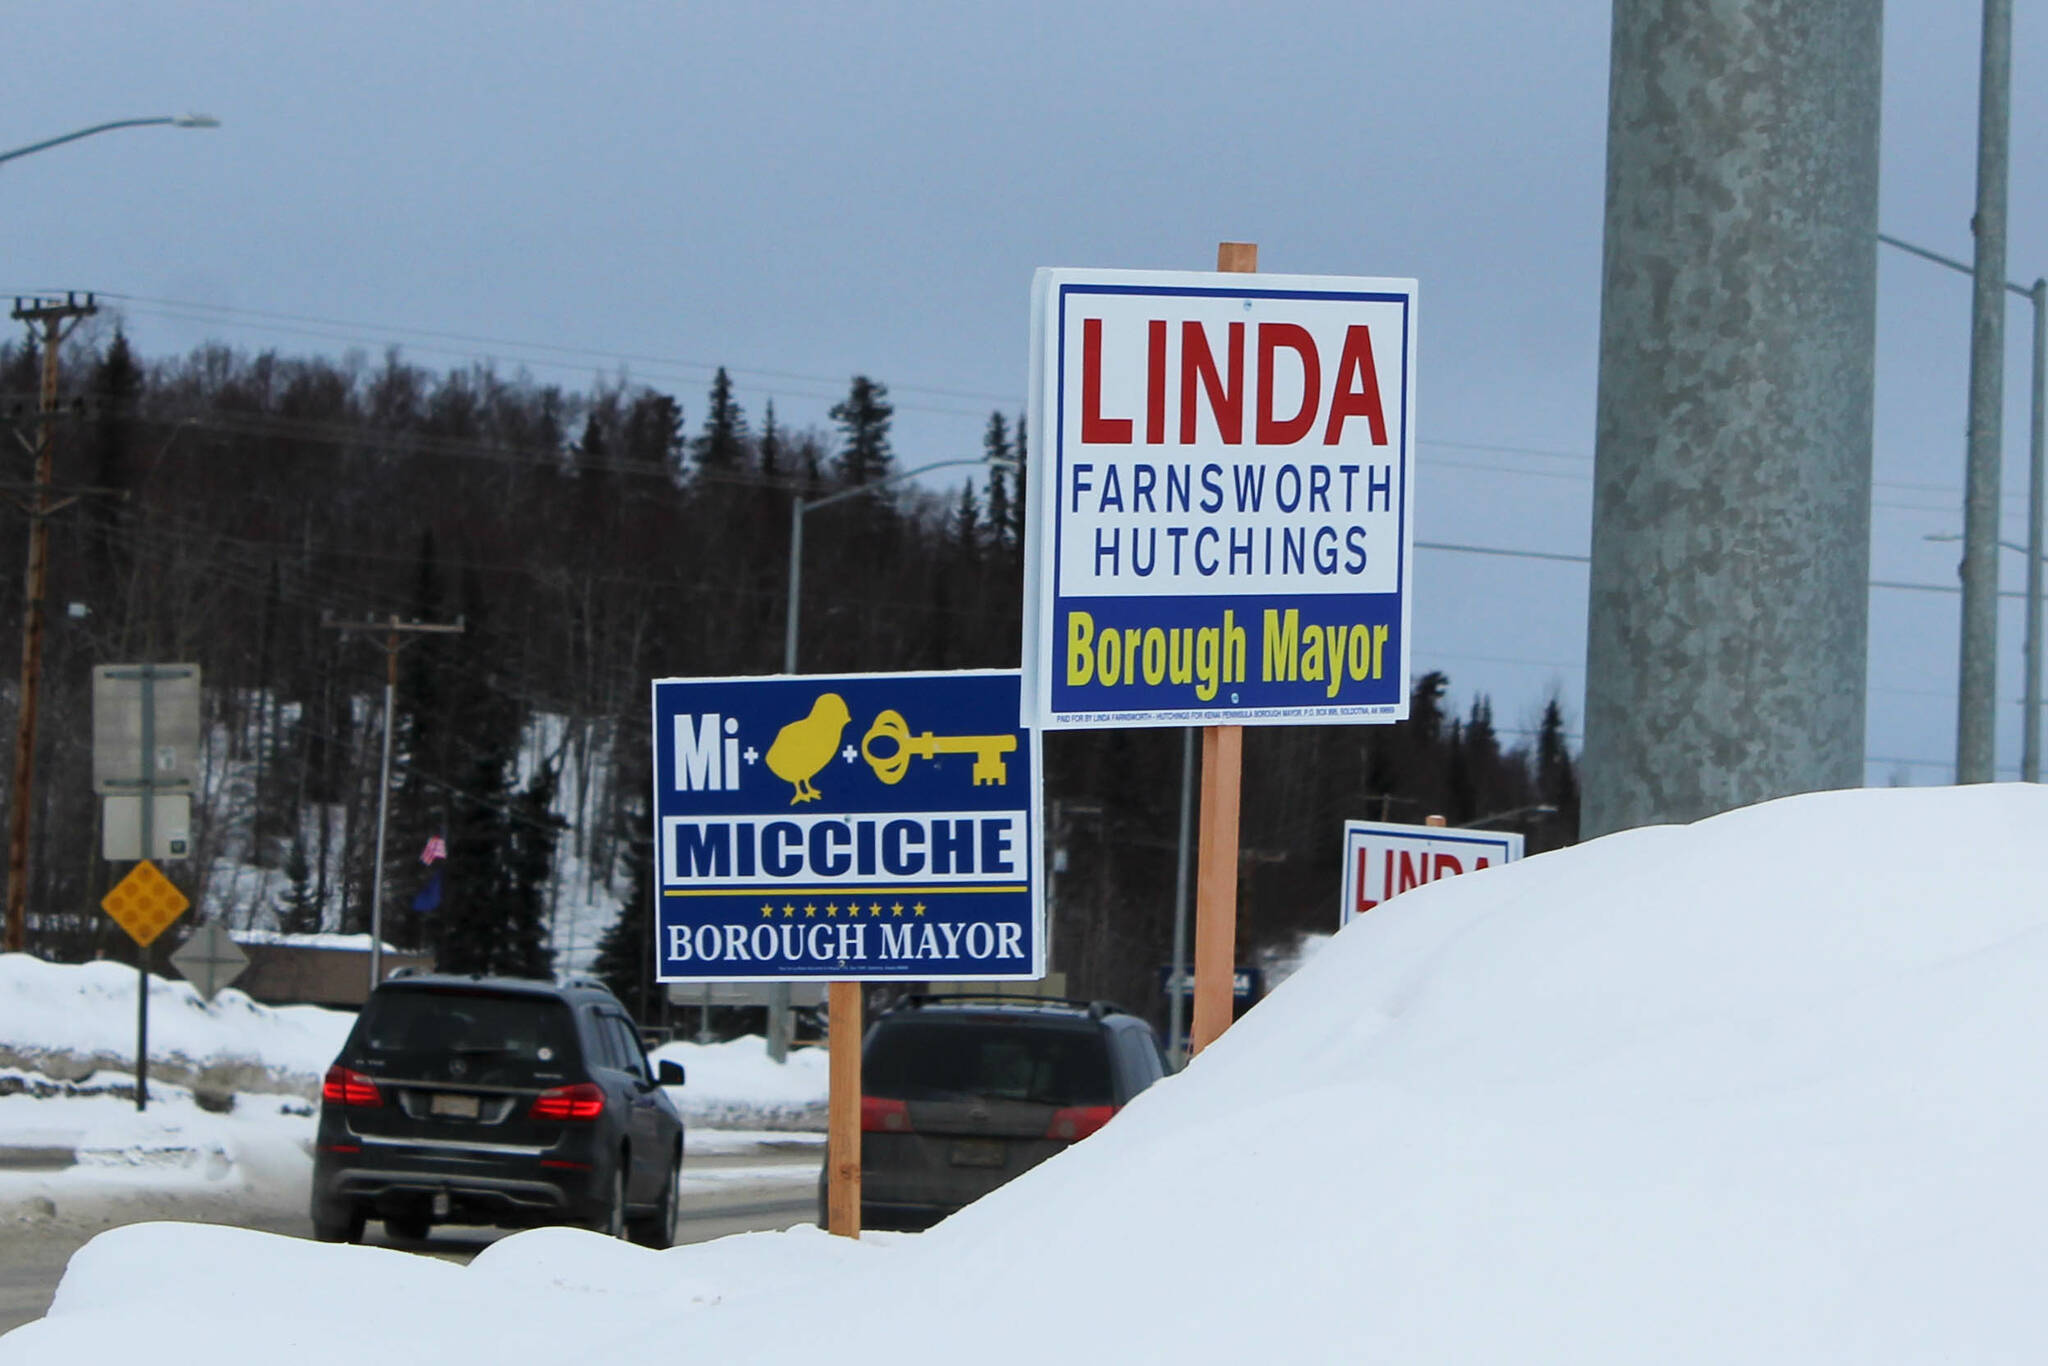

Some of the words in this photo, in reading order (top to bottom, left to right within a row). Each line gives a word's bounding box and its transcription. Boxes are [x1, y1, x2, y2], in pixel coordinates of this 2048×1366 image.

[1081, 318, 1388, 446] LINDA
[1071, 463, 1391, 513] FARNSWORTH
[1094, 526, 1367, 577] HUTCHINGS
[1066, 609, 1247, 702] Borough
[1262, 608, 1389, 698] Mayor
[1057, 714, 1070, 723] PAID
[1072, 714, 1083, 722] FOR
[1094, 712, 1110, 722] LINDA
[1112, 711, 1152, 721] FARNSWORTH
[1156, 711, 1190, 720] HUTCHINGS
[1191, 711, 1203, 720] FOR
[1254, 709, 1281, 718] BOROUGH
[675, 818, 1014, 878] MICCICHE
[1356, 847, 1490, 912] LIN
[667, 923, 868, 961] BOROUGH
[879, 921, 1025, 960] MAYOR
